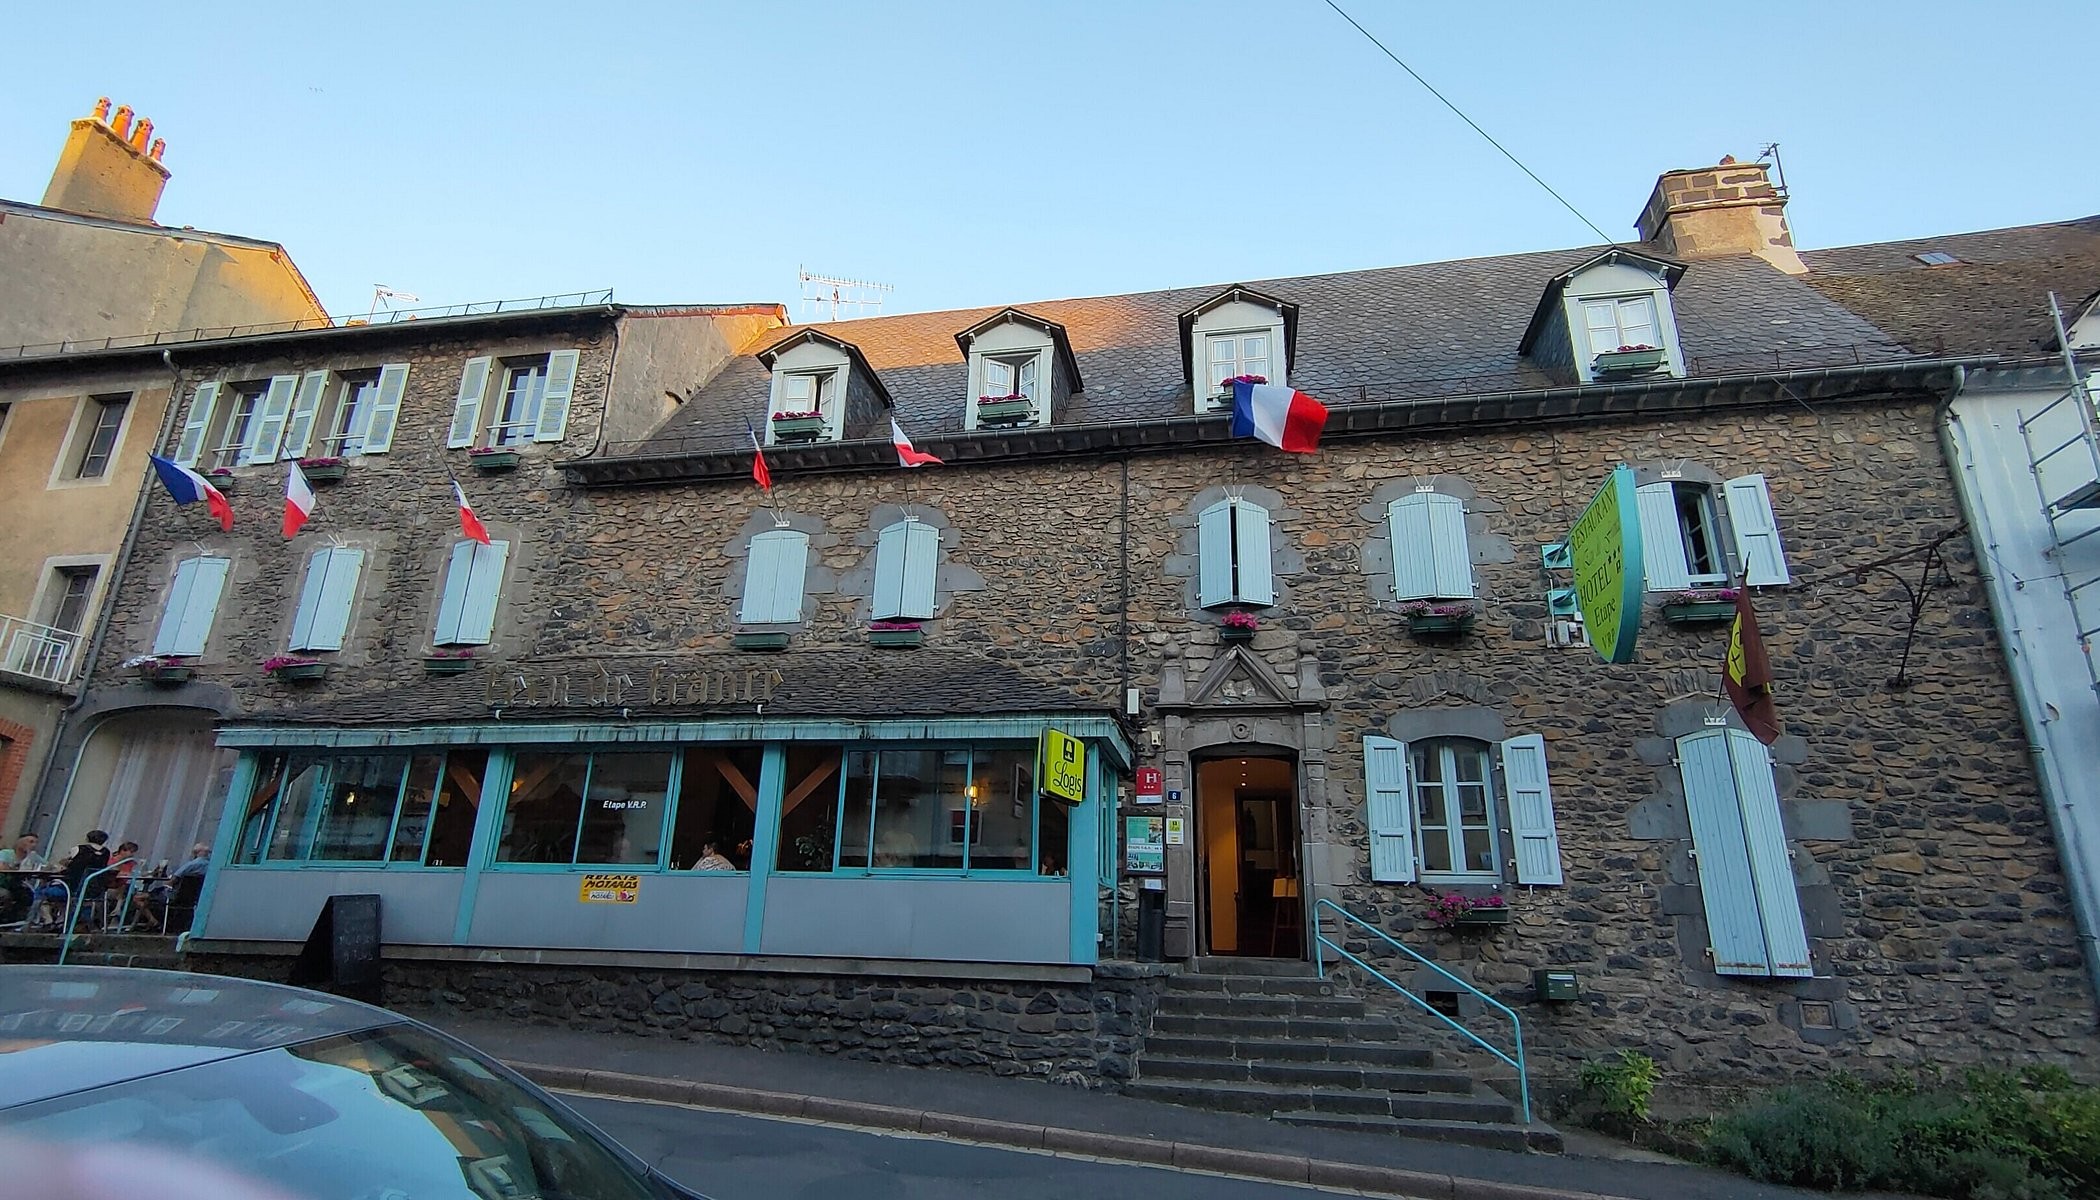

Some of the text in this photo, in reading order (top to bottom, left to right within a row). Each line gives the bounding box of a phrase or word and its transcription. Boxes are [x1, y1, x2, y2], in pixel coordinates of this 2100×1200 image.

[1570, 480, 1617, 553] RESTAURANT
[1579, 564, 1612, 612] HOTEL
[1594, 597, 1616, 627] Etape
[1602, 628, 1616, 650] VRP
[1053, 761, 1082, 797] Logis
[1145, 772, 1158, 784] H
[603, 800, 625, 810] Etape
[1172, 792, 1177, 800] 6
[584, 880, 638, 889] MOTARDS
